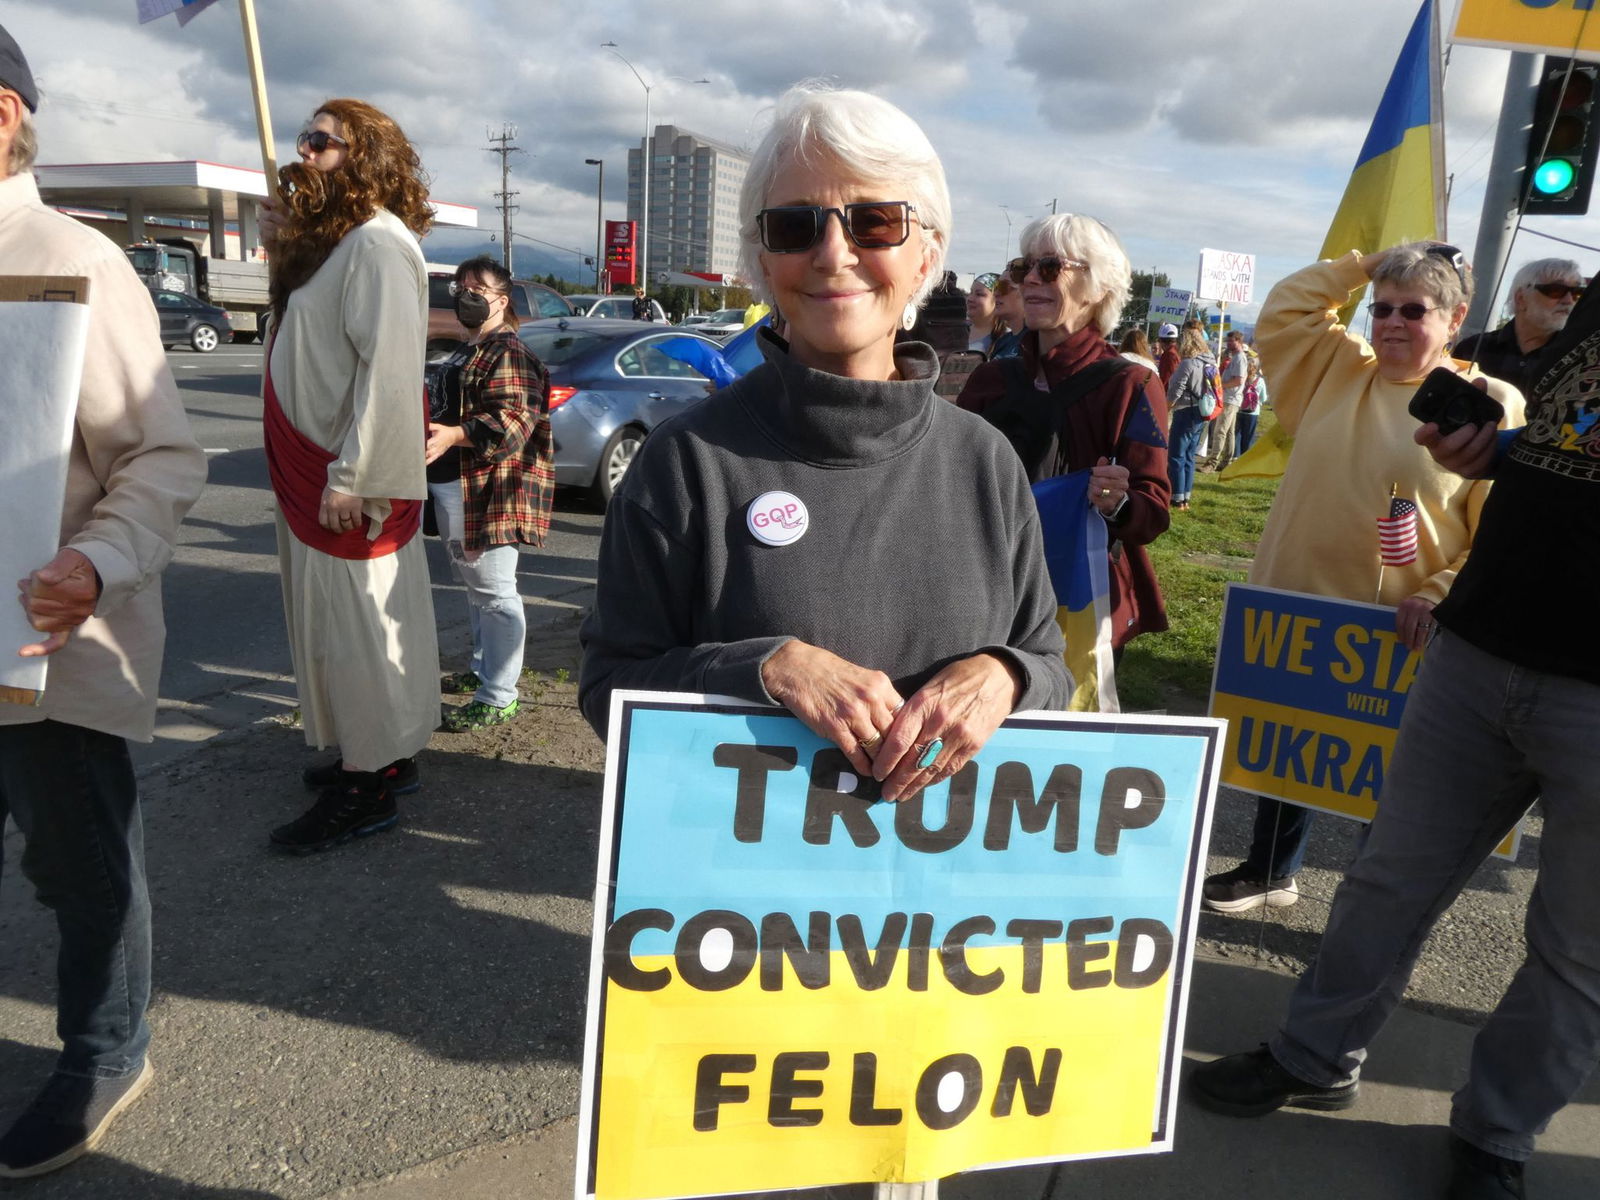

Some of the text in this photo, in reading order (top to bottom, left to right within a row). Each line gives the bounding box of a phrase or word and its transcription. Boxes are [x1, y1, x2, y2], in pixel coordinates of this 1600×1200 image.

[1216, 252, 1252, 273] ASKA
[1230, 273, 1251, 284] WITH
[1214, 282, 1250, 303] RAINE
[1243, 607, 1321, 676] WE
[1347, 691, 1390, 717] WITH
[712, 742, 1166, 856] TRUMP
[603, 907, 1173, 996] CONVICTED
[693, 1046, 1062, 1132] FELON
